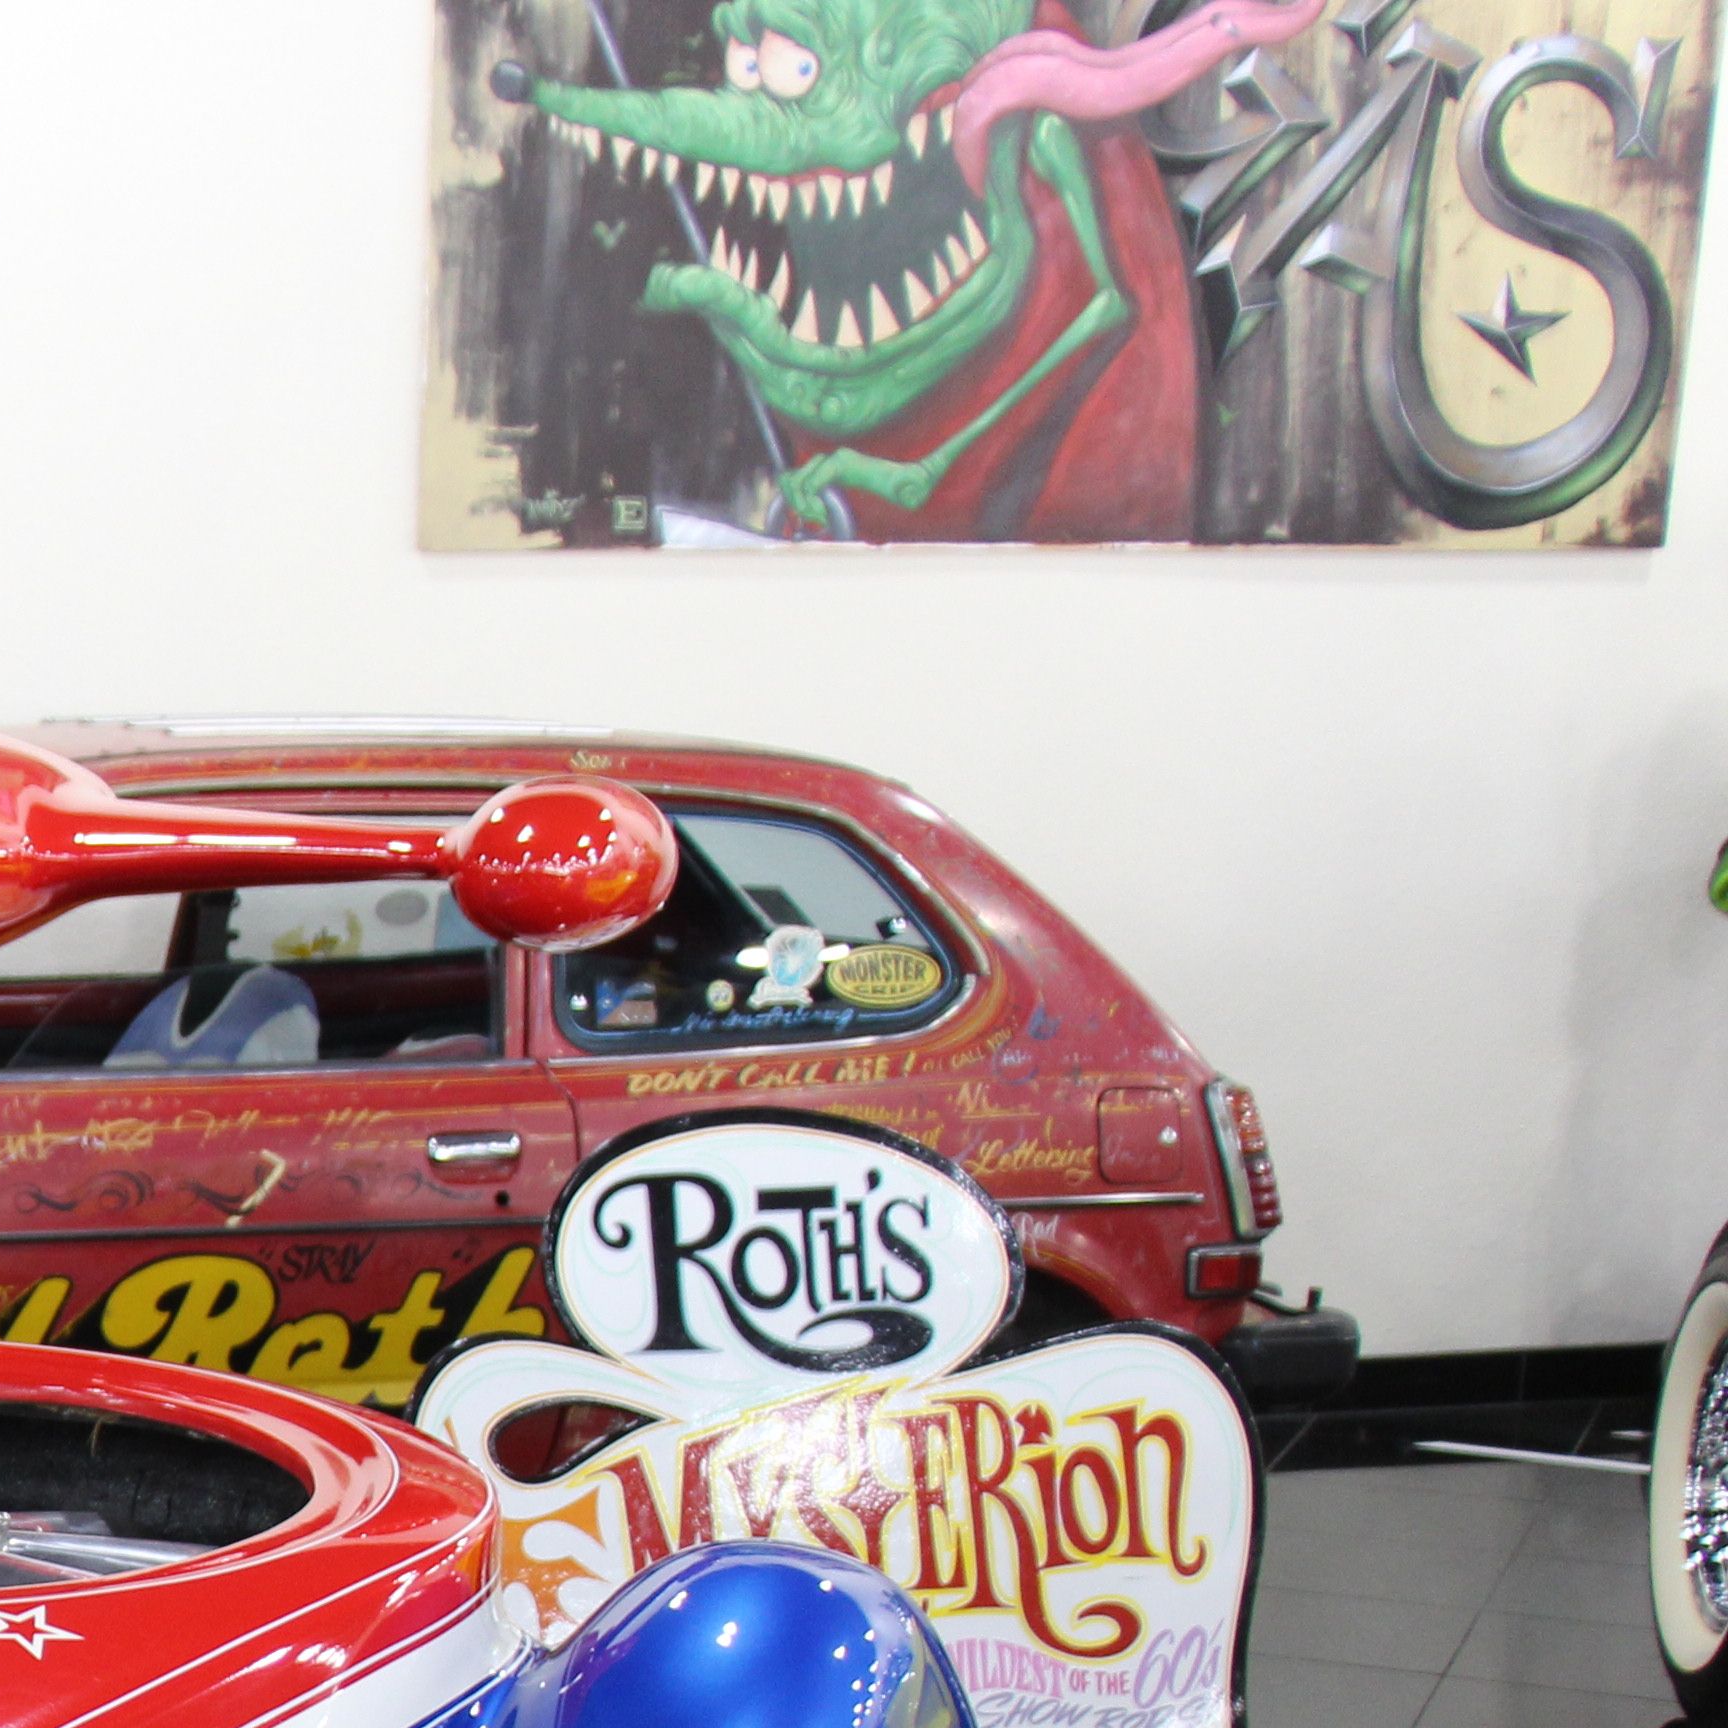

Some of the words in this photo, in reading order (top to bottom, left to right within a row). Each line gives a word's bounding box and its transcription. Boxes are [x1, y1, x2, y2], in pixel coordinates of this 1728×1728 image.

[840, 951, 927, 982] MONSTER
[627, 1061, 733, 1094] DON'T
[737, 1062, 827, 1088] CALL
[1069, 1667, 1091, 1693] OF
[1095, 1670, 1132, 1696] THE
